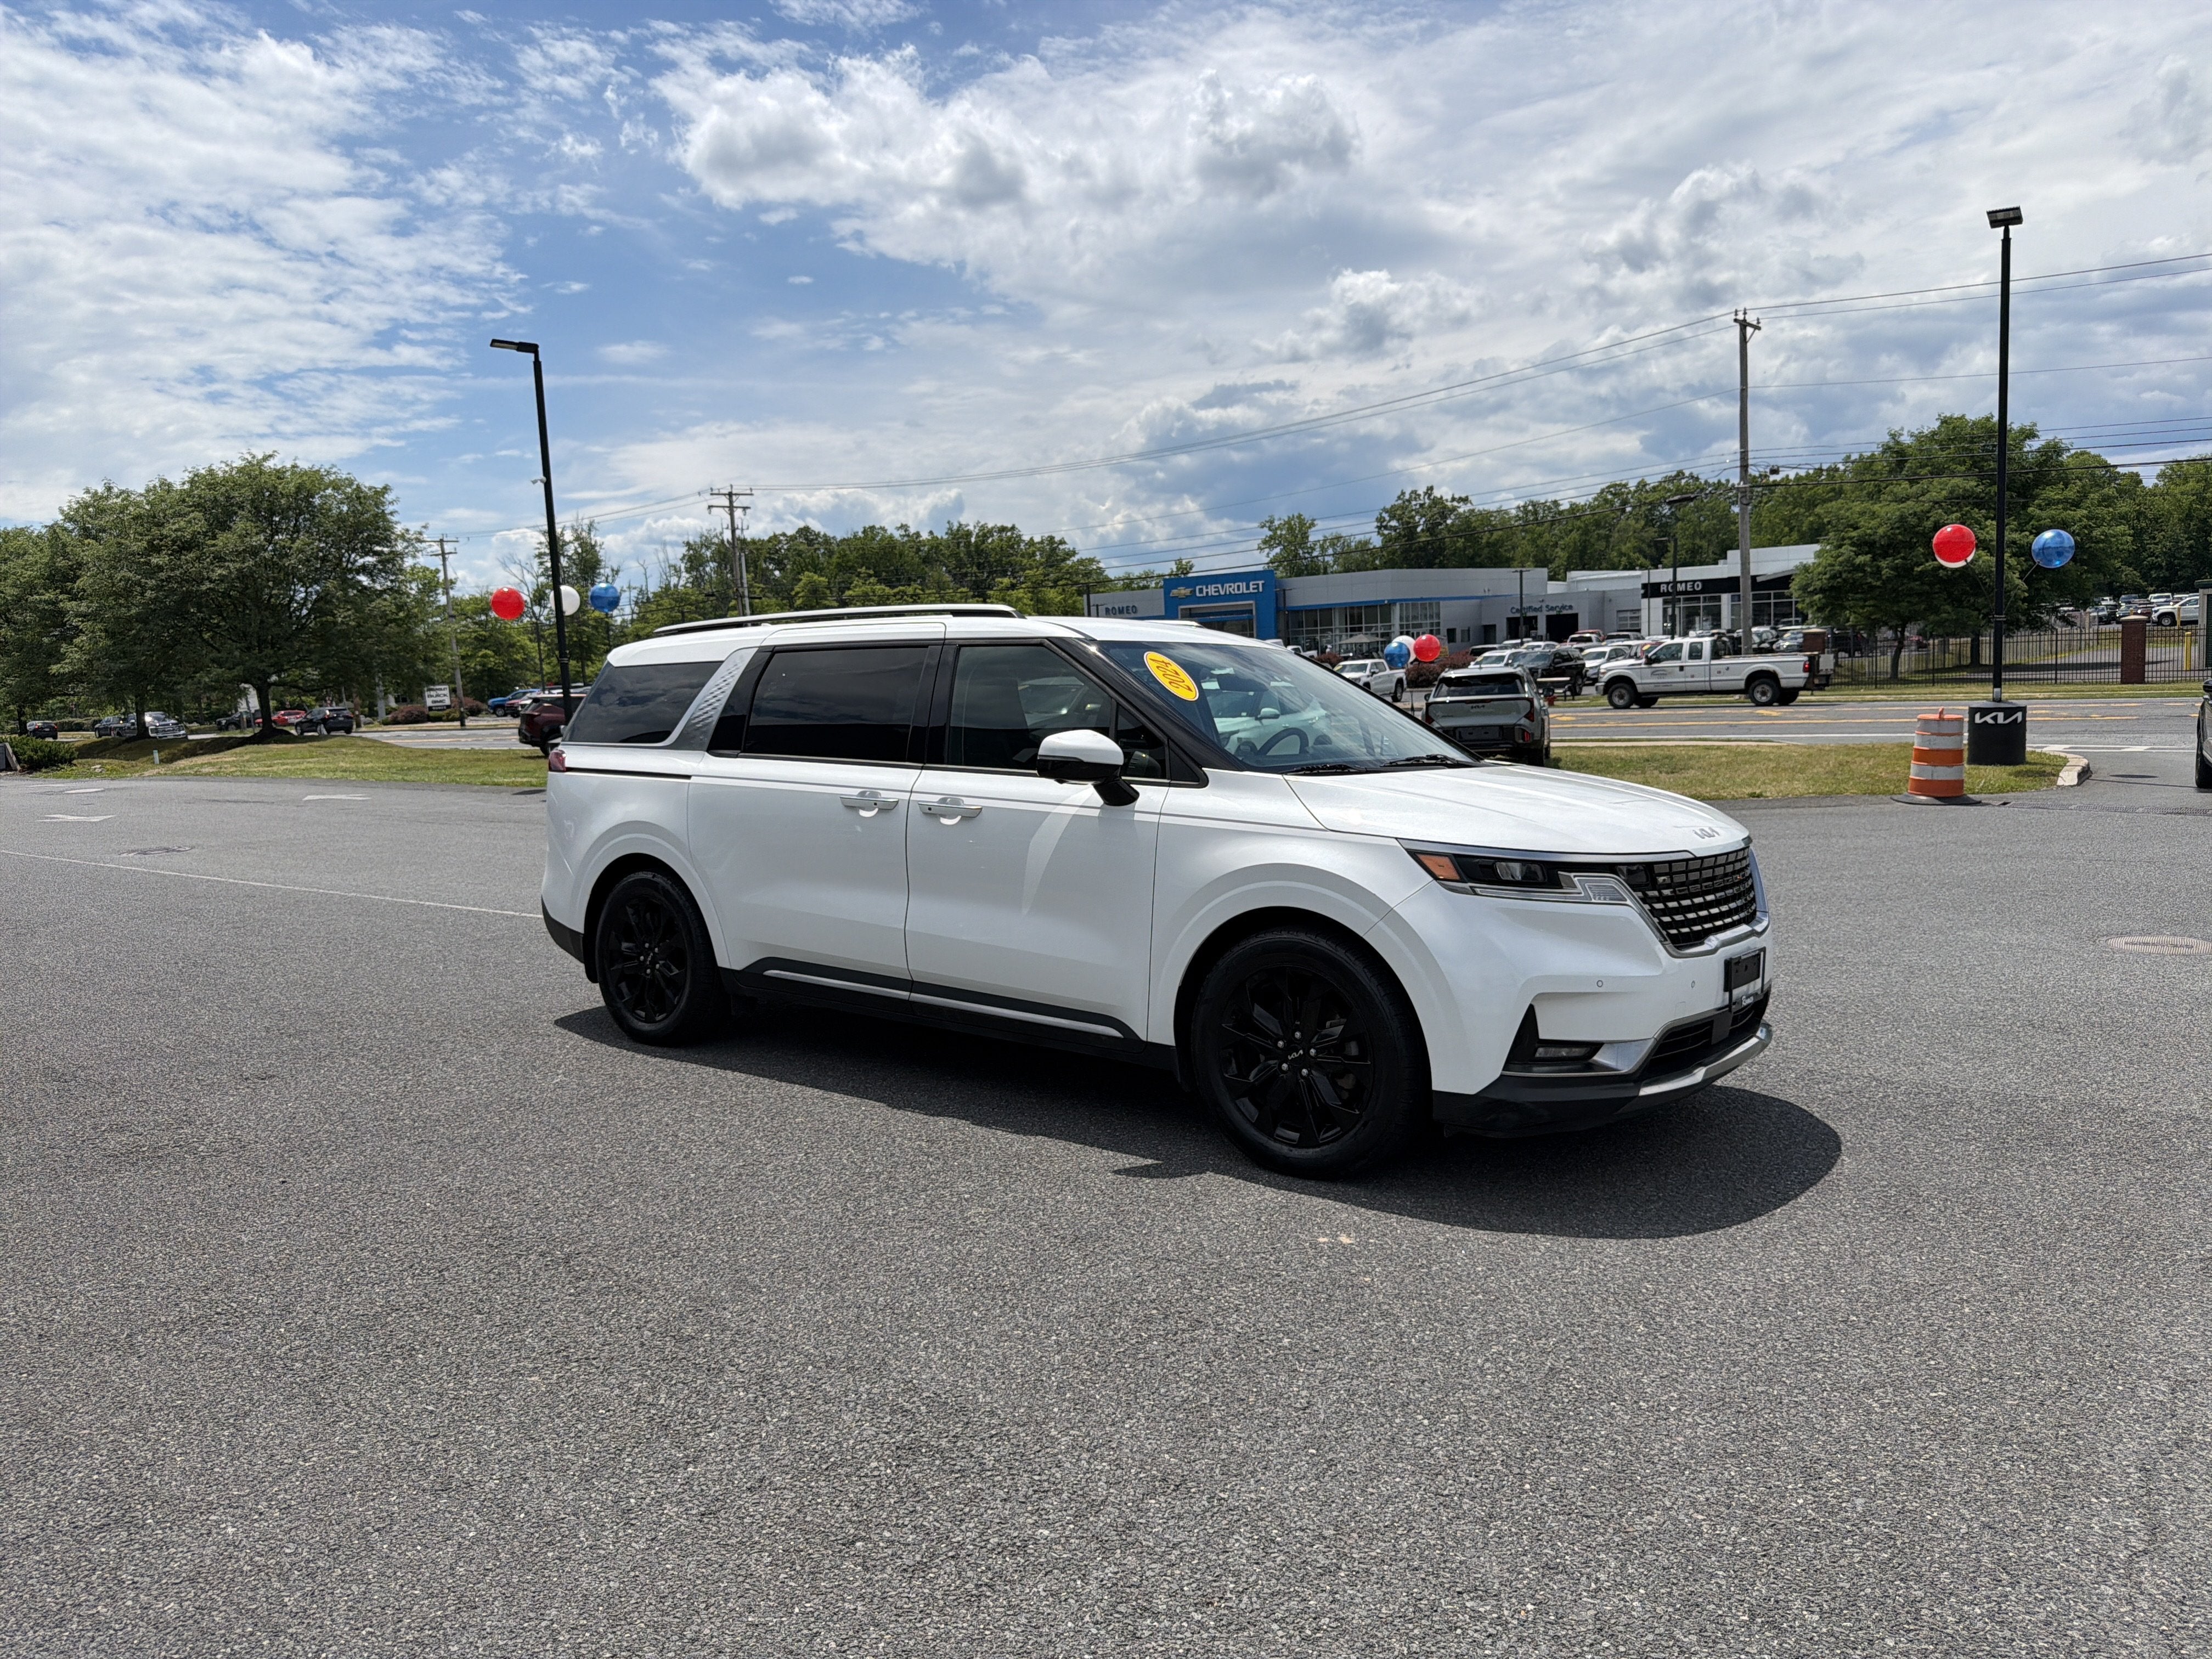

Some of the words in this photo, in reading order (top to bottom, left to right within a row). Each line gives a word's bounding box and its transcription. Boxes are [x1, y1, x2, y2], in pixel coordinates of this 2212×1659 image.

[1195, 580, 1265, 597] CHEVROLET
[1660, 582, 1702, 593] ROMEO
[1105, 605, 1138, 616] ROMEO
[1510, 605, 1543, 614] Cetified
[1545, 604, 1573, 612] Service
[1149, 658, 1193, 692] 2024
[1975, 711, 2022, 724] KIA
[1692, 827, 1720, 839] KIA
[1288, 1049, 1304, 1060] KIA
